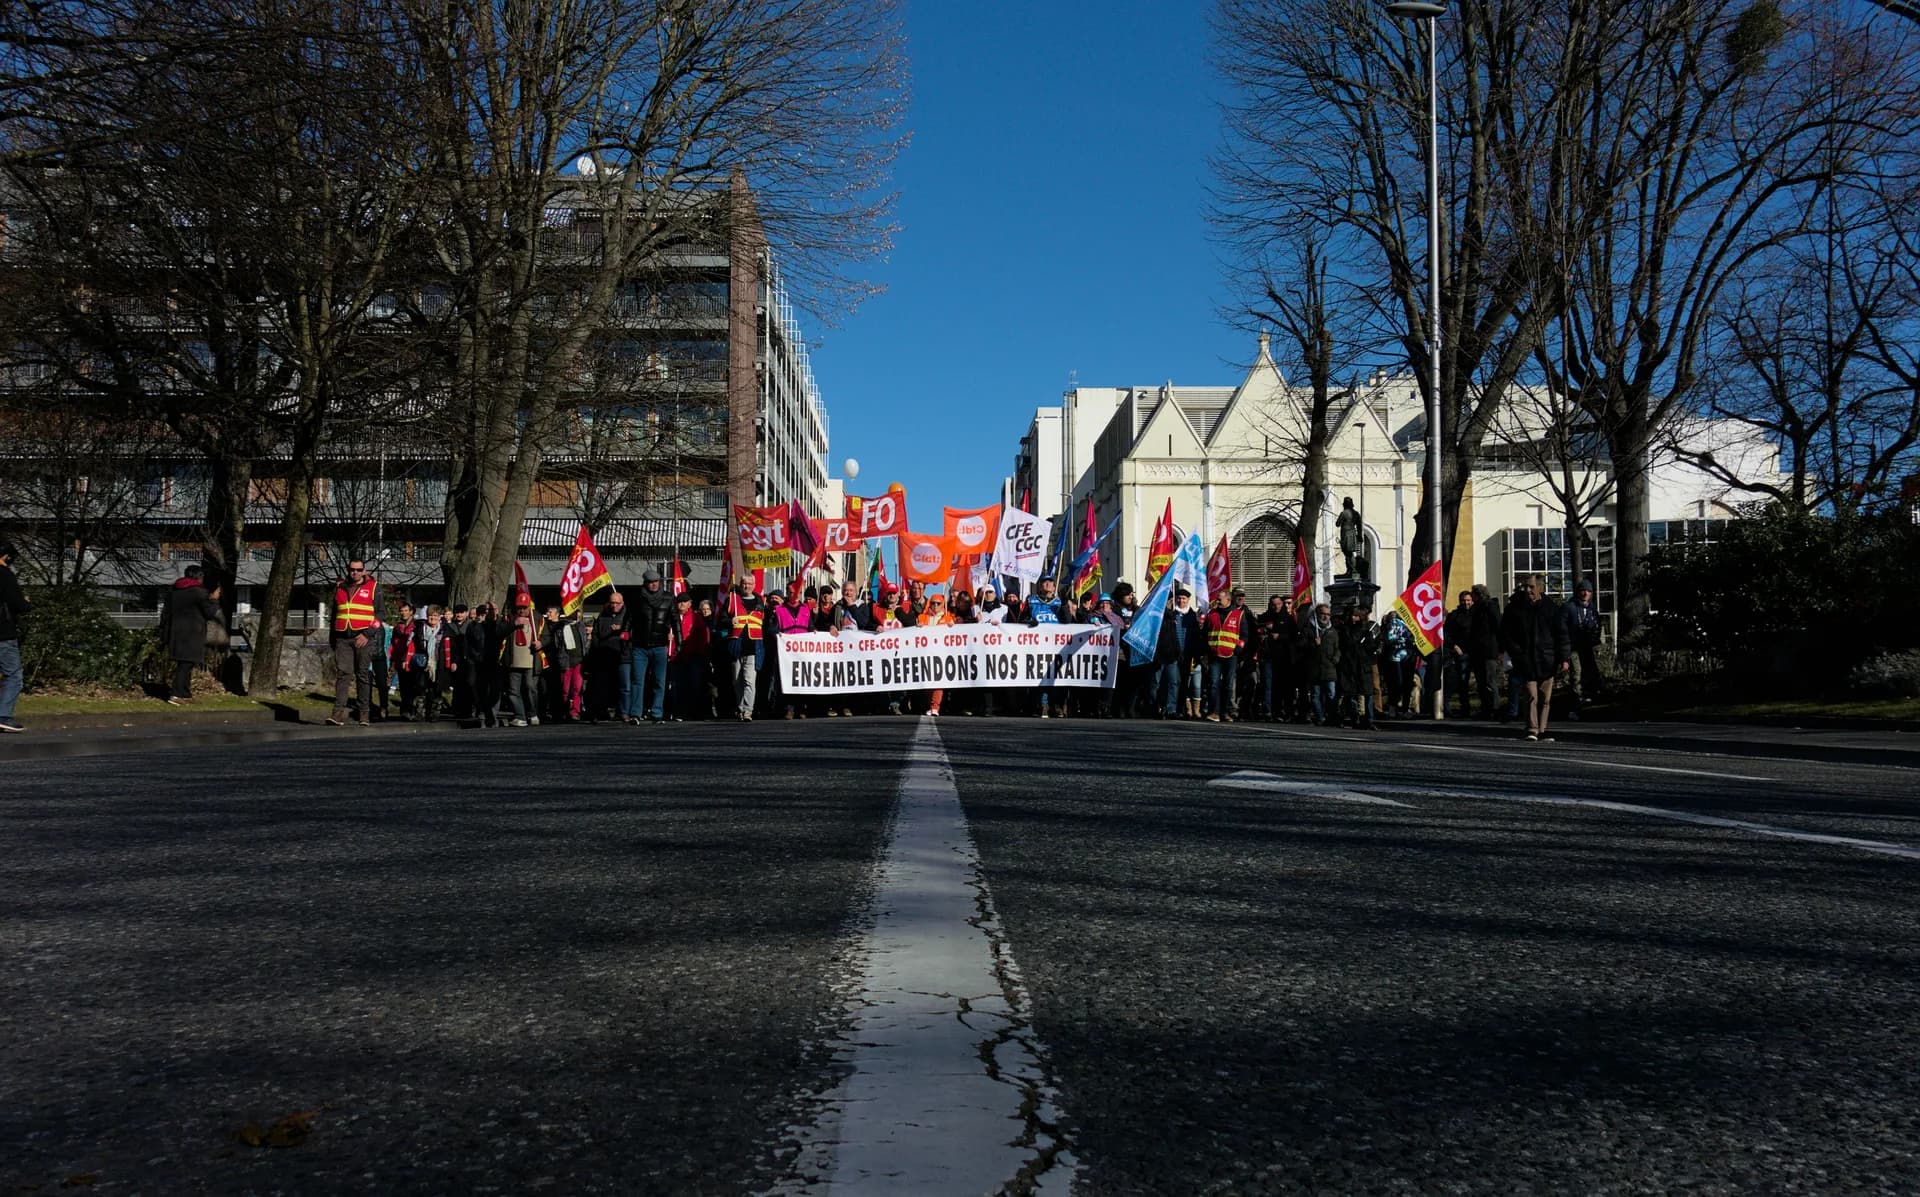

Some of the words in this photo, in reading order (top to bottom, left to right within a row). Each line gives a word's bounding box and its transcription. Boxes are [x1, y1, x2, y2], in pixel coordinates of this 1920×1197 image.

[861, 496, 896, 533] FO
[739, 519, 785, 550] cgt
[824, 522, 849, 547] FO
[1005, 521, 1034, 540] CFE
[1015, 534, 1043, 553] CGC
[1413, 583, 1444, 640] cg
[785, 640, 844, 653] SOLIDAIRES
[858, 637, 900, 652] CFE-CGC
[914, 636, 928, 648] FO
[943, 634, 968, 647] CFDT
[983, 633, 1003, 646] CGT
[1017, 633, 1040, 646] CFTC
[1054, 633, 1073, 646] FSU
[1088, 634, 1115, 647] UNSA
[791, 659, 874, 688] ENSEMBLE
[881, 651, 978, 684] DÉFENDONS
[985, 653, 1018, 680] NOS
[1025, 653, 1108, 681] RETRAITES
